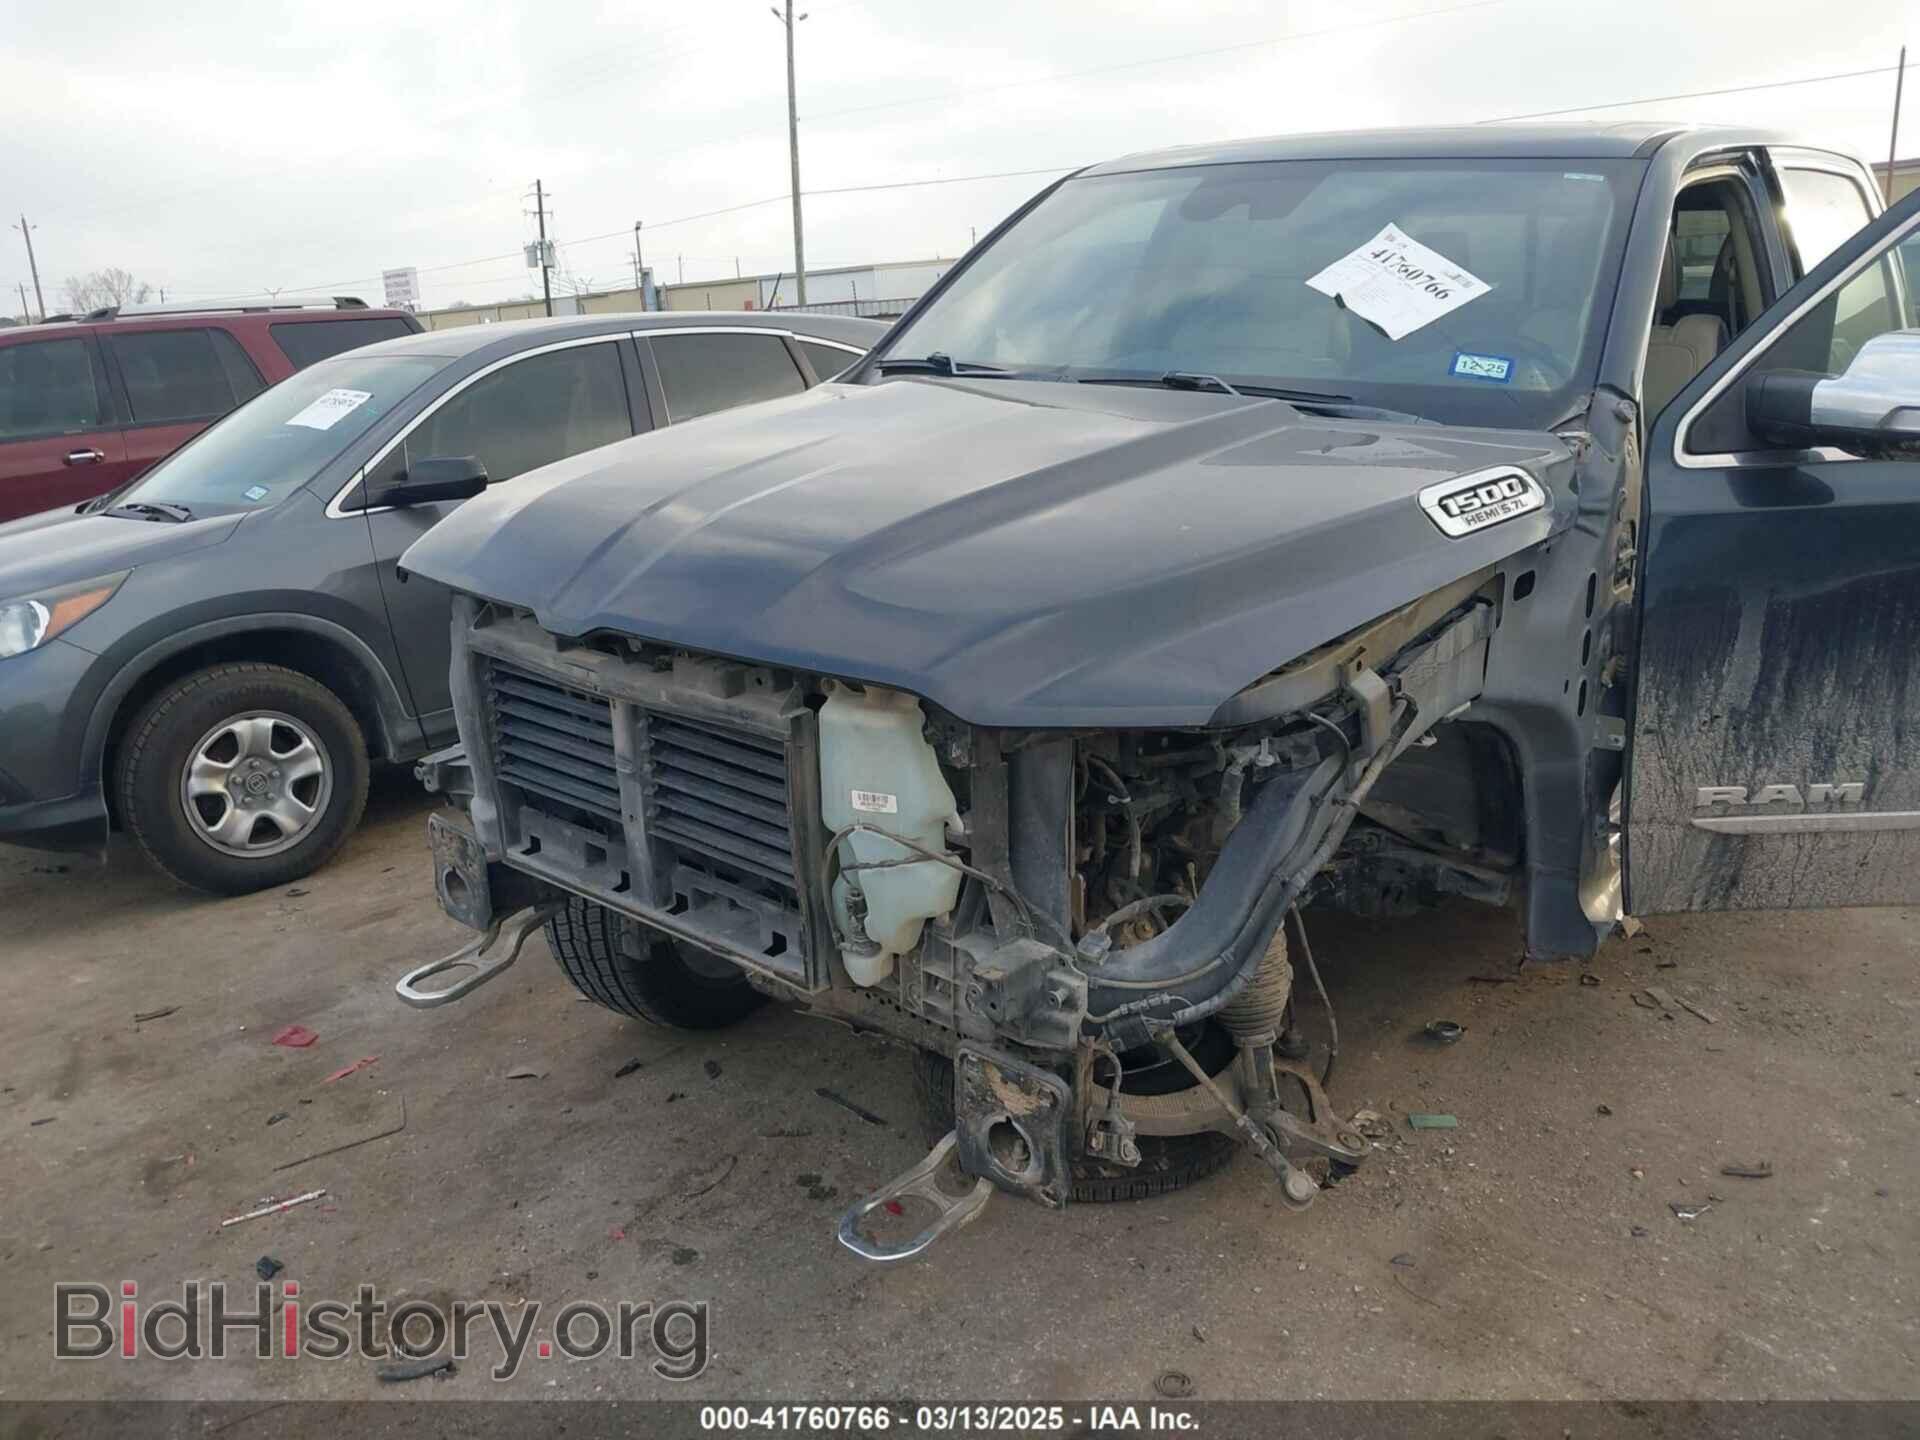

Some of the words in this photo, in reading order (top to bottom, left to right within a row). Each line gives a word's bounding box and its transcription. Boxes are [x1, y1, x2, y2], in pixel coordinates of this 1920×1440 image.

[1371, 249, 1455, 300] 41760766
[1440, 478, 1523, 516] 1500
[1464, 506, 1500, 527] HEMI
[1502, 498, 1529, 514] 5.7L
[1696, 782, 1865, 809] RAM
